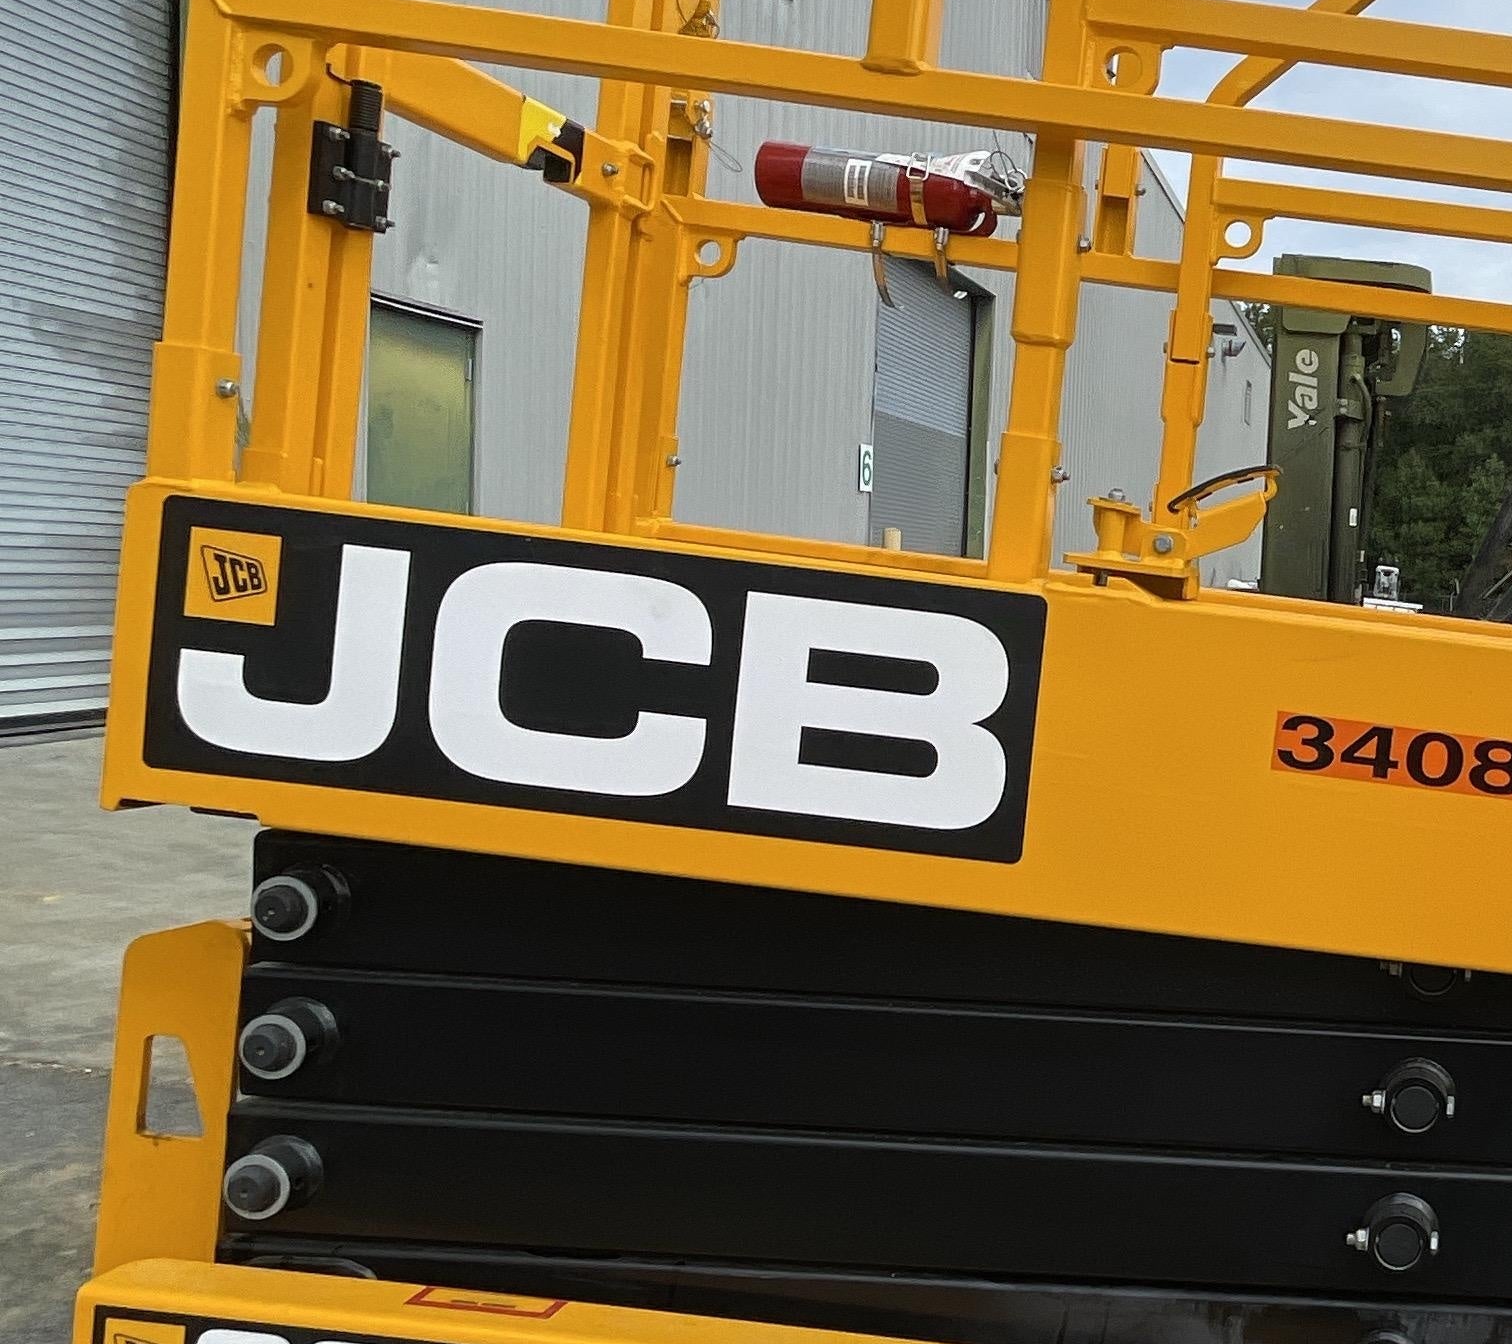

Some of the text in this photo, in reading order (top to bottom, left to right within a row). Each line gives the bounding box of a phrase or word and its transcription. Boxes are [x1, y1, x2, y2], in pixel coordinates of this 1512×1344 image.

[1286, 348, 1320, 431] Yale
[862, 450, 872, 486] 6
[212, 551, 263, 596] JCB
[176, 543, 1011, 832] JCB
